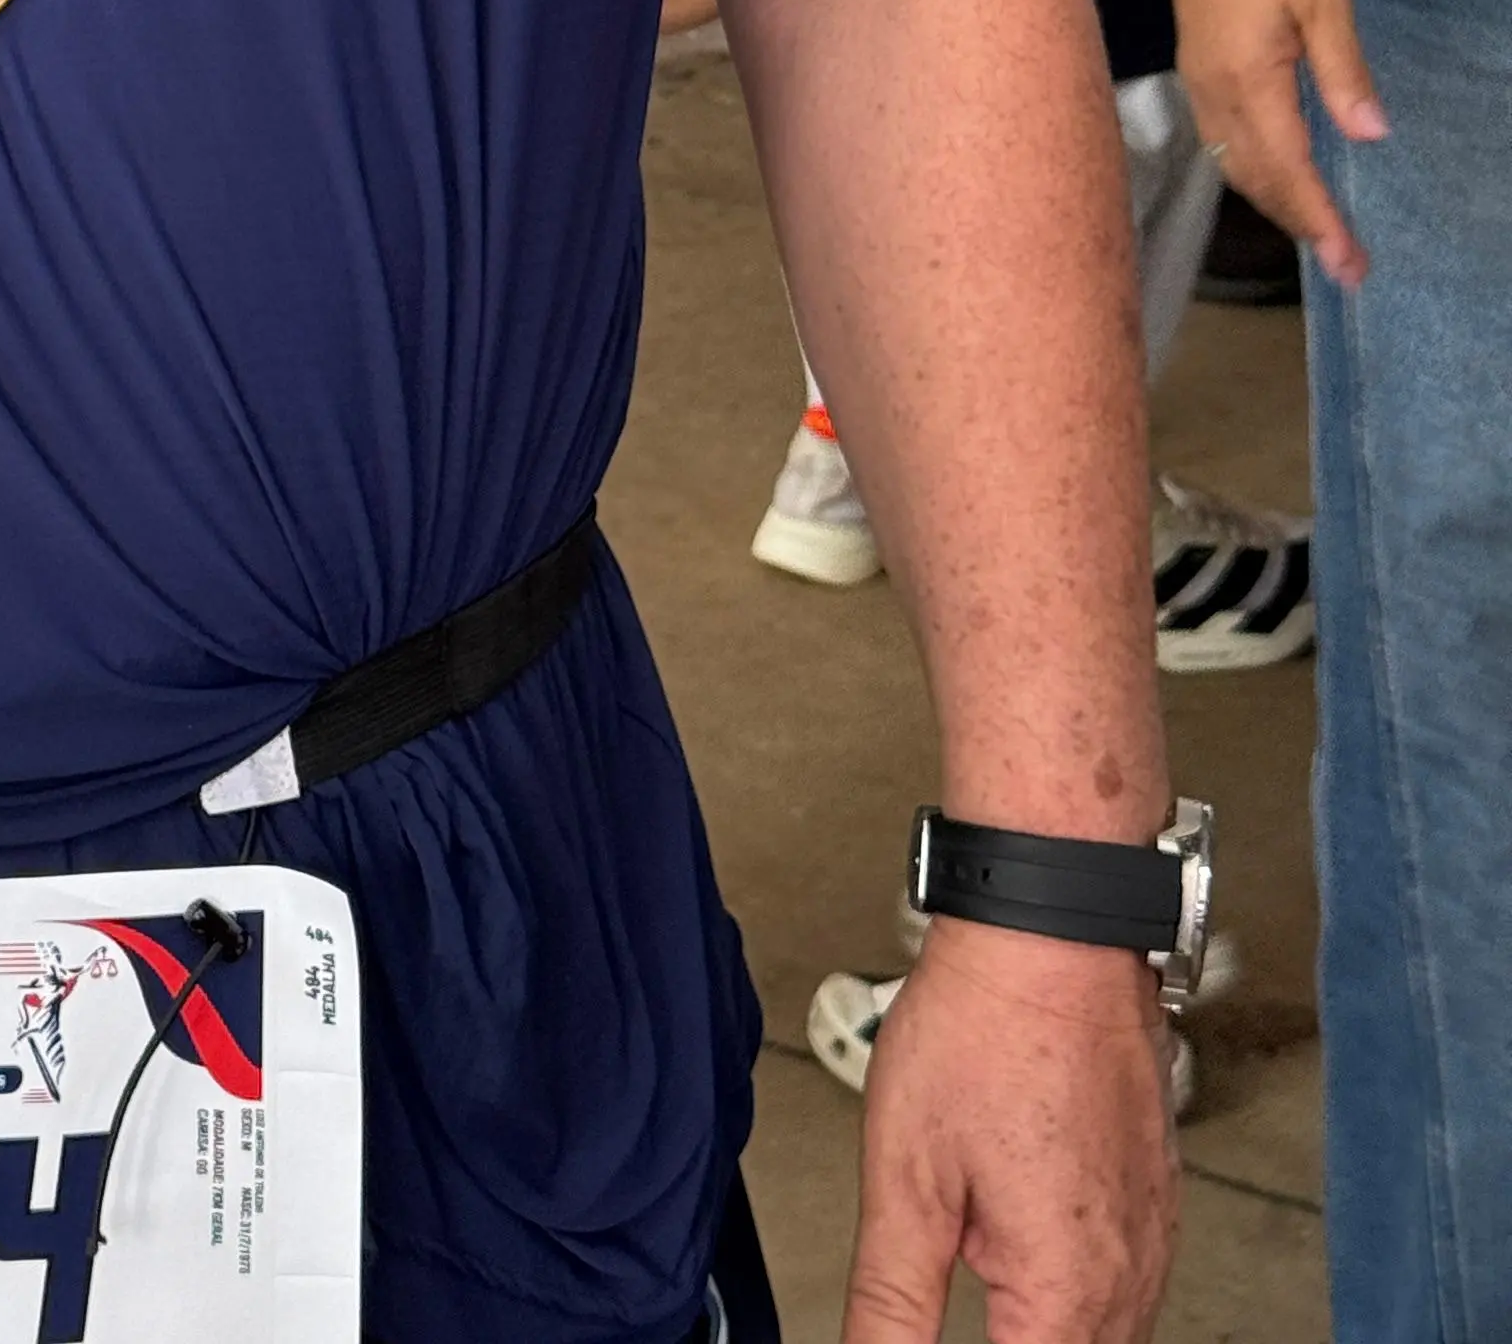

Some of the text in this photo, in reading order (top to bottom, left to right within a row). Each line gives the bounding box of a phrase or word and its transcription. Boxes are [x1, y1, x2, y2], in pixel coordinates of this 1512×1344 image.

[322, 953, 336, 1025] MEDALHA
[212, 1109, 225, 1184] MODALIDADE:
[241, 1140, 252, 1151] M
[211, 1212, 224, 1247] GERAL
